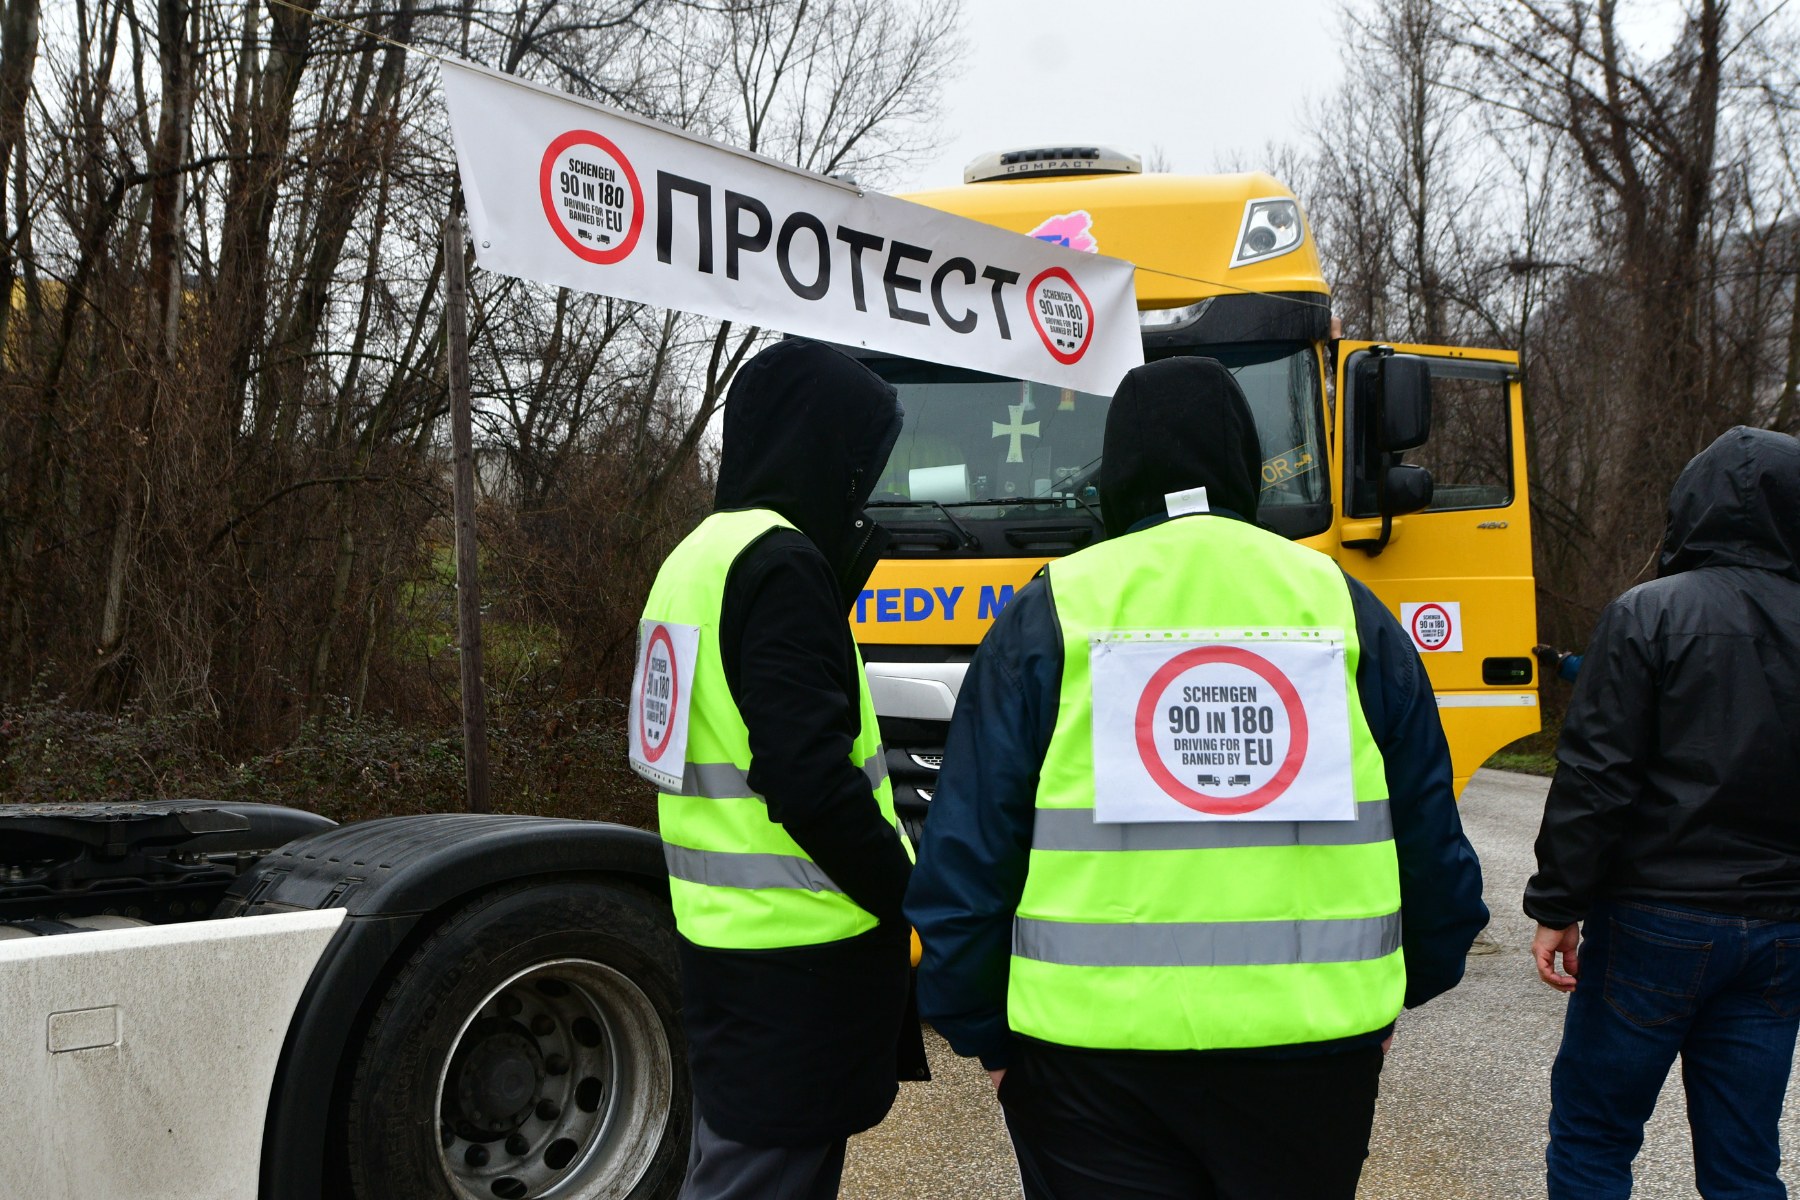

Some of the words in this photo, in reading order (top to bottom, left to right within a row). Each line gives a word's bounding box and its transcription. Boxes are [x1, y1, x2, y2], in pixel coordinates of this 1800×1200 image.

[569, 158, 615, 182] SCHENGEN
[1007, 161, 1094, 173] COMPACT
[560, 171, 579, 197] 90
[582, 182, 595, 201] IN
[598, 182, 624, 209] 180
[564, 196, 590, 213] DRIVING
[591, 205, 604, 217] FOR
[569, 209, 595, 225] BANNED
[596, 216, 604, 228] BY
[605, 209, 622, 232] EU
[656, 169, 1021, 341] ПРОТЕСТ
[1043, 289, 1073, 302] SCHENGEN
[1039, 299, 1054, 316] 90
[1055, 304, 1064, 318] IN
[1064, 303, 1082, 320] 180
[1072, 322, 1082, 338] EU
[856, 586, 965, 623] TEDY
[978, 585, 1015, 620] M
[1420, 620, 1428, 629] 90
[659, 675, 670, 700] 180
[1183, 686, 1257, 703] SCHENGEN
[659, 702, 667, 726] EU
[1168, 705, 1200, 734] 90
[1206, 711, 1226, 734] IN
[1231, 705, 1274, 734] 180
[1174, 738, 1217, 751] DRIVING
[1220, 738, 1240, 751] FOR
[1244, 738, 1273, 766] EU
[1182, 752, 1225, 766] BANNED
[1227, 752, 1241, 766] BY
